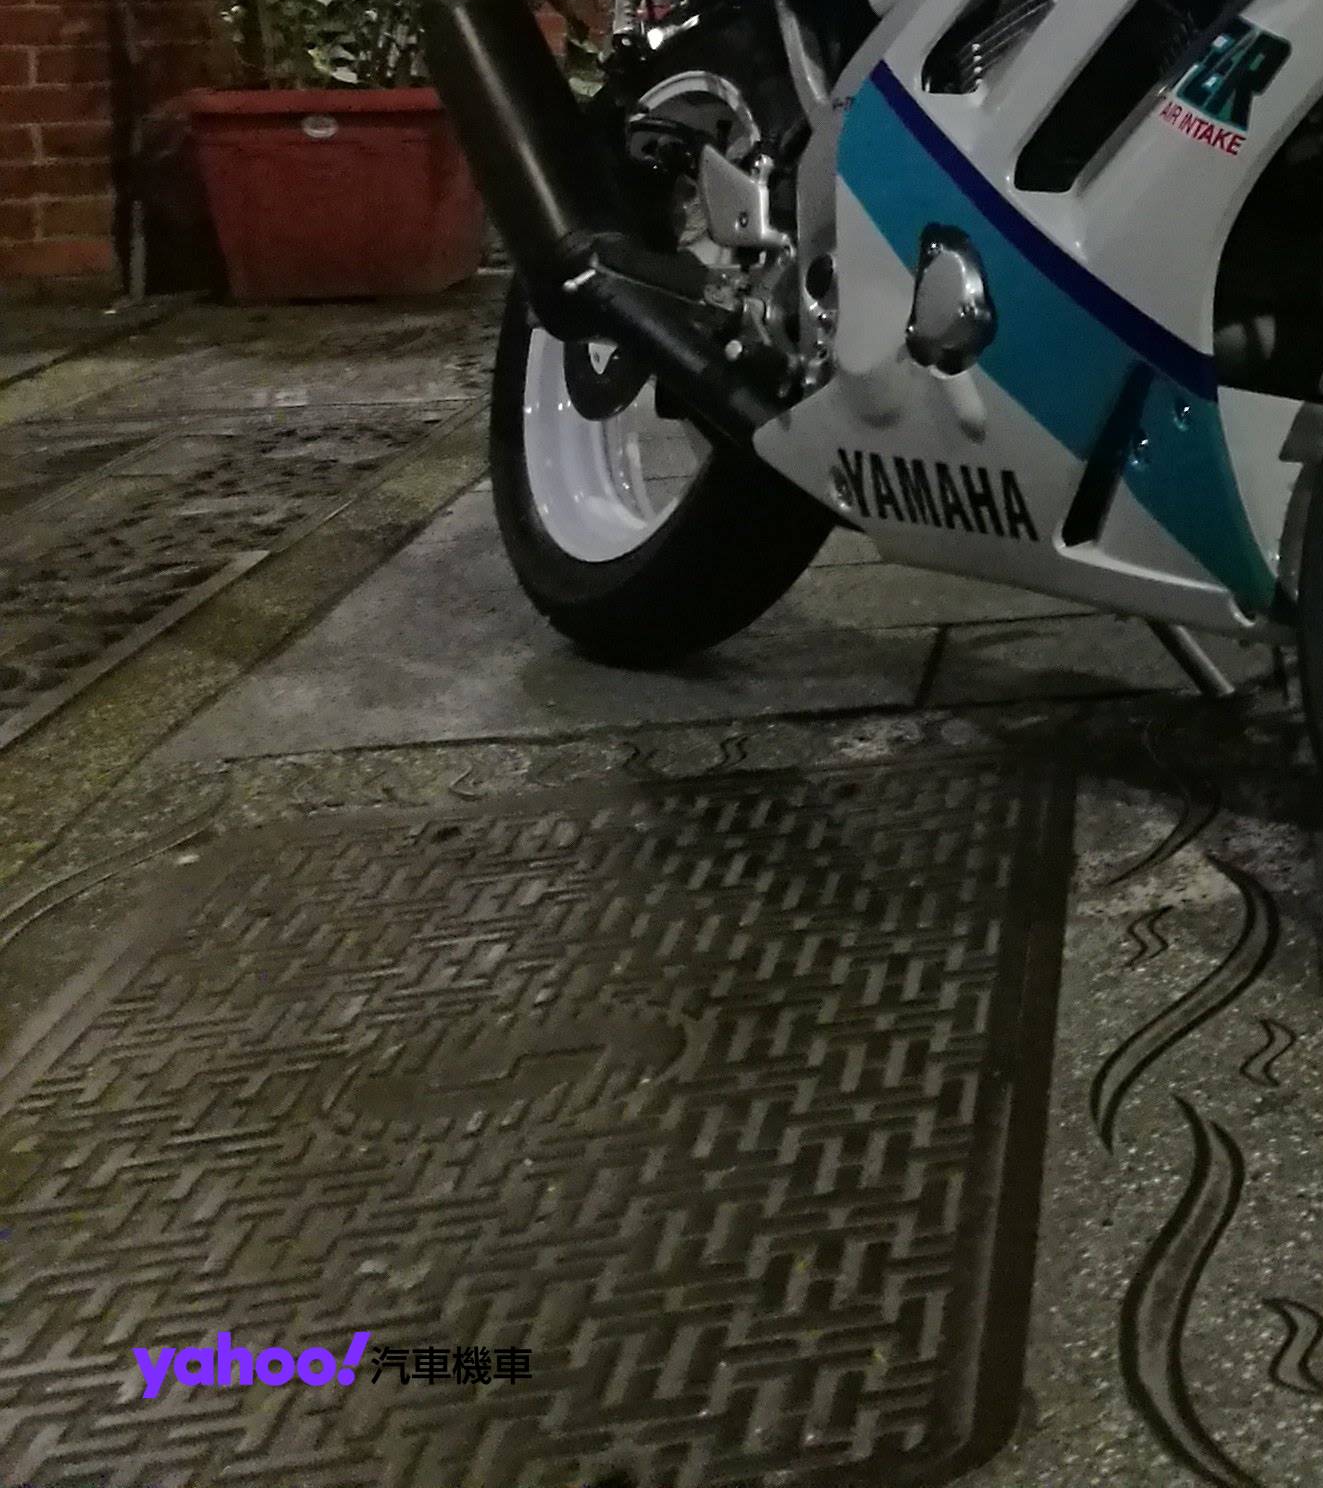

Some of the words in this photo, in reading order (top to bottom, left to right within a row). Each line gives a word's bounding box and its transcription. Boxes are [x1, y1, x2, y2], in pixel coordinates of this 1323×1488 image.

[1159, 102, 1183, 126] AIR
[1178, 112, 1247, 156] INTAKE
[837, 447, 1040, 543] YAMAHA
